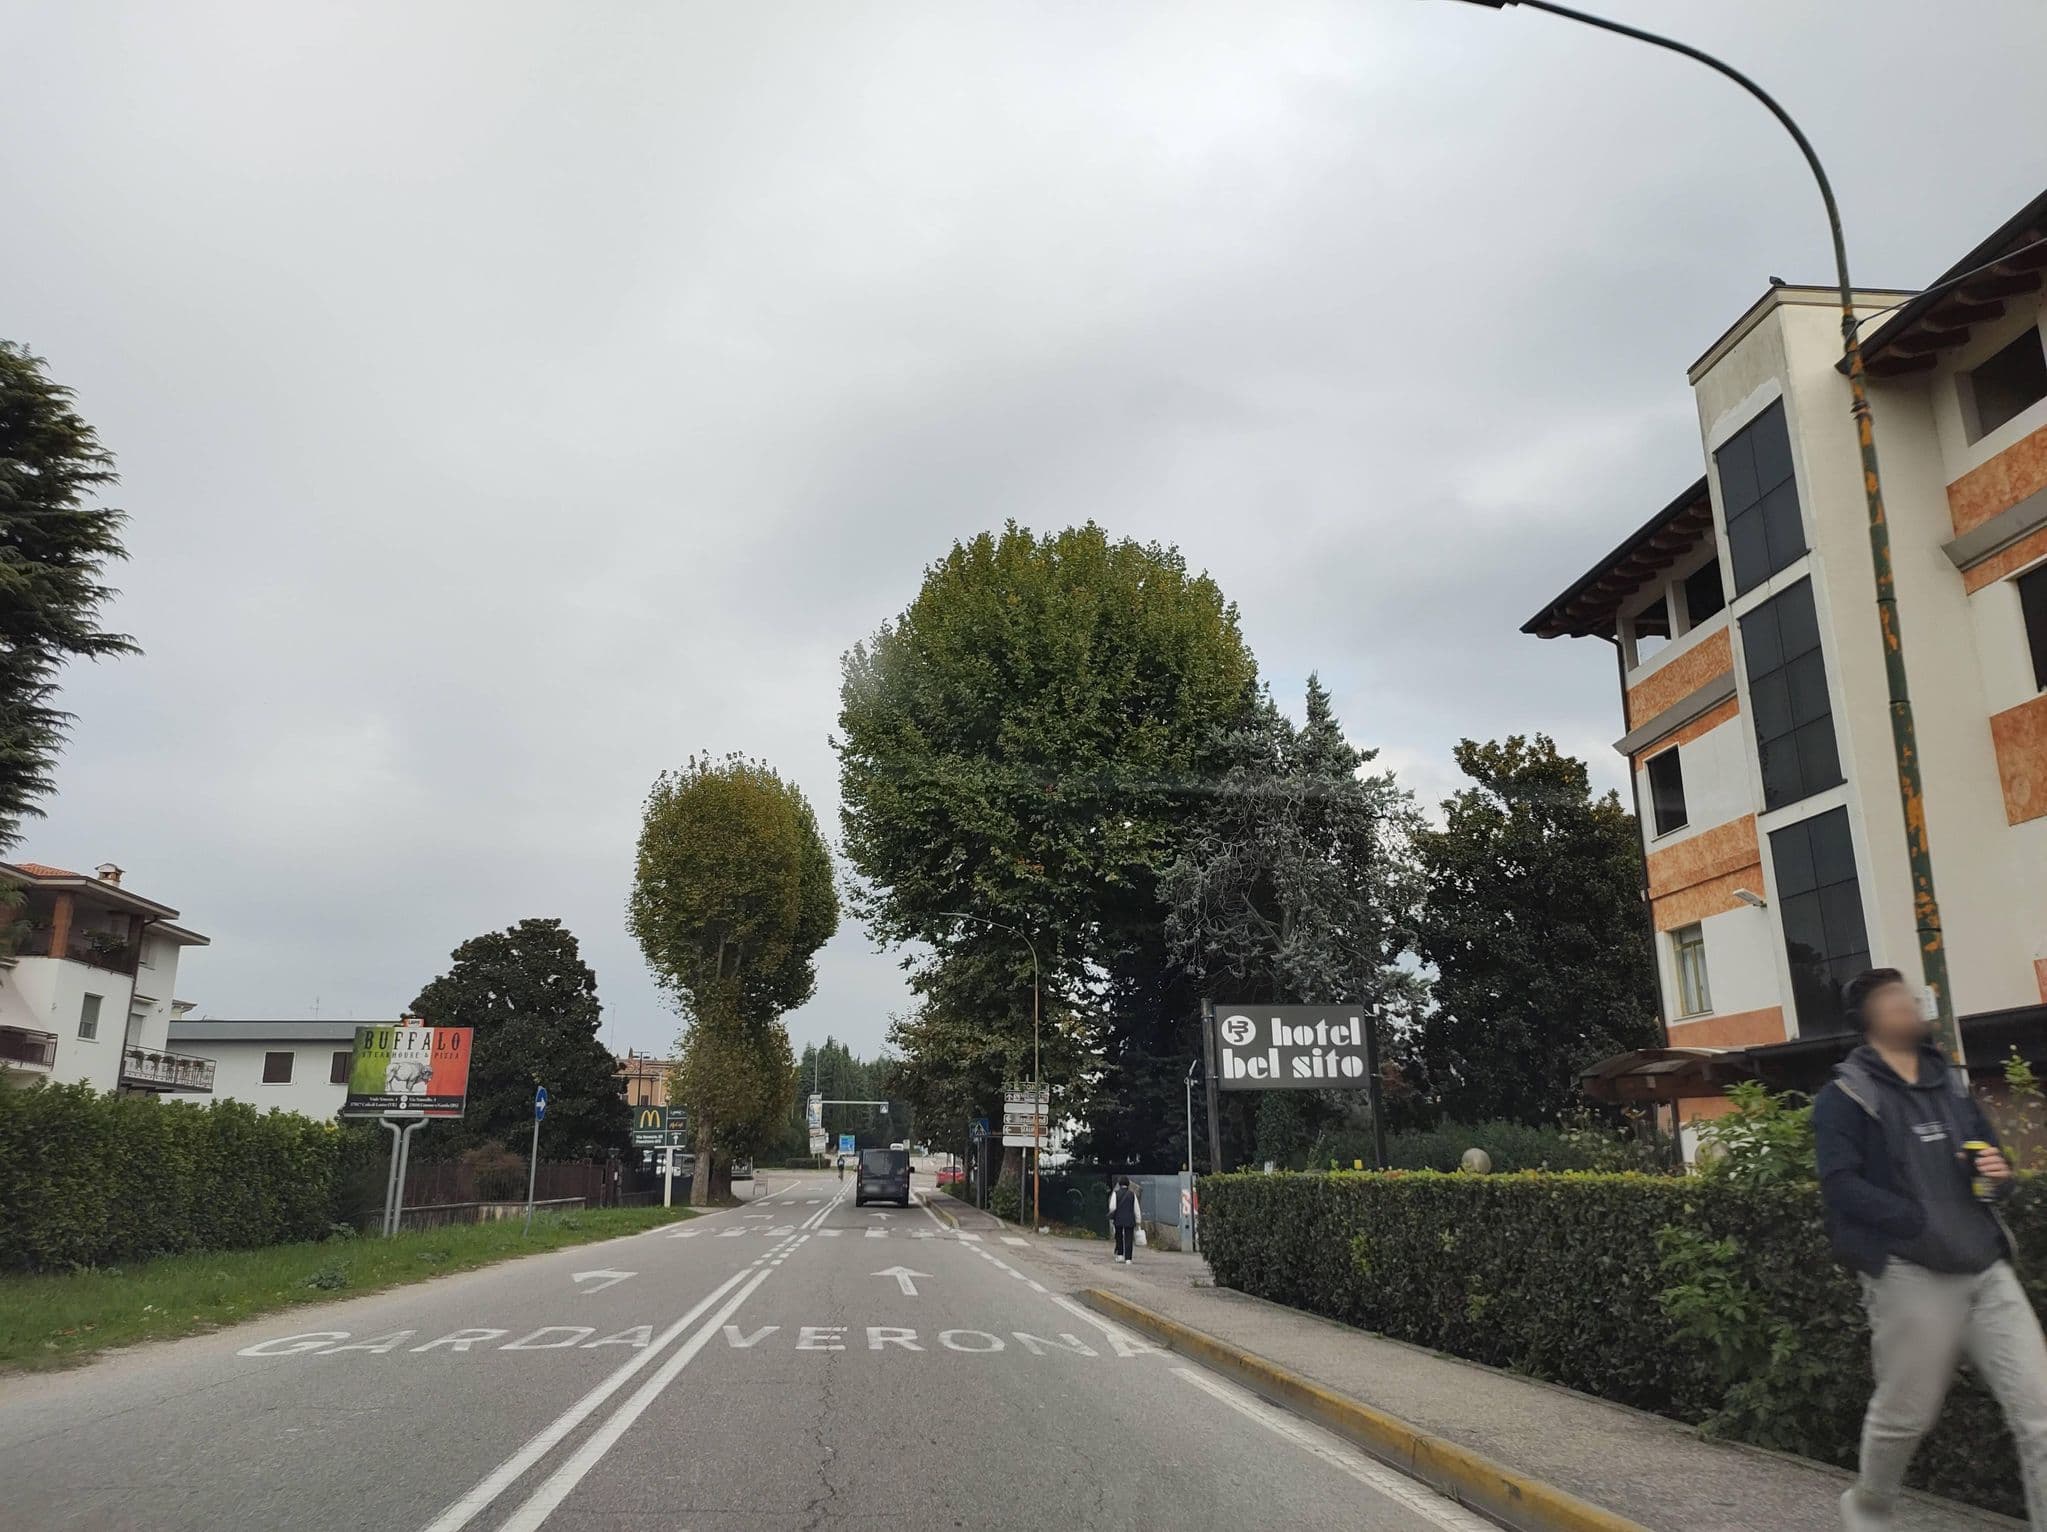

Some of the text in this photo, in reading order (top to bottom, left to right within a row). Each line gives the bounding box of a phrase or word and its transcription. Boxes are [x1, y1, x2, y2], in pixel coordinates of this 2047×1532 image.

[364, 1031, 461, 1050] BUFFALO
[1271, 1016, 1362, 1046] hotel
[1222, 1047, 1364, 1079] bel sito
[236, 1324, 653, 1357] GARDA
[722, 1325, 1174, 1359] VERONA
